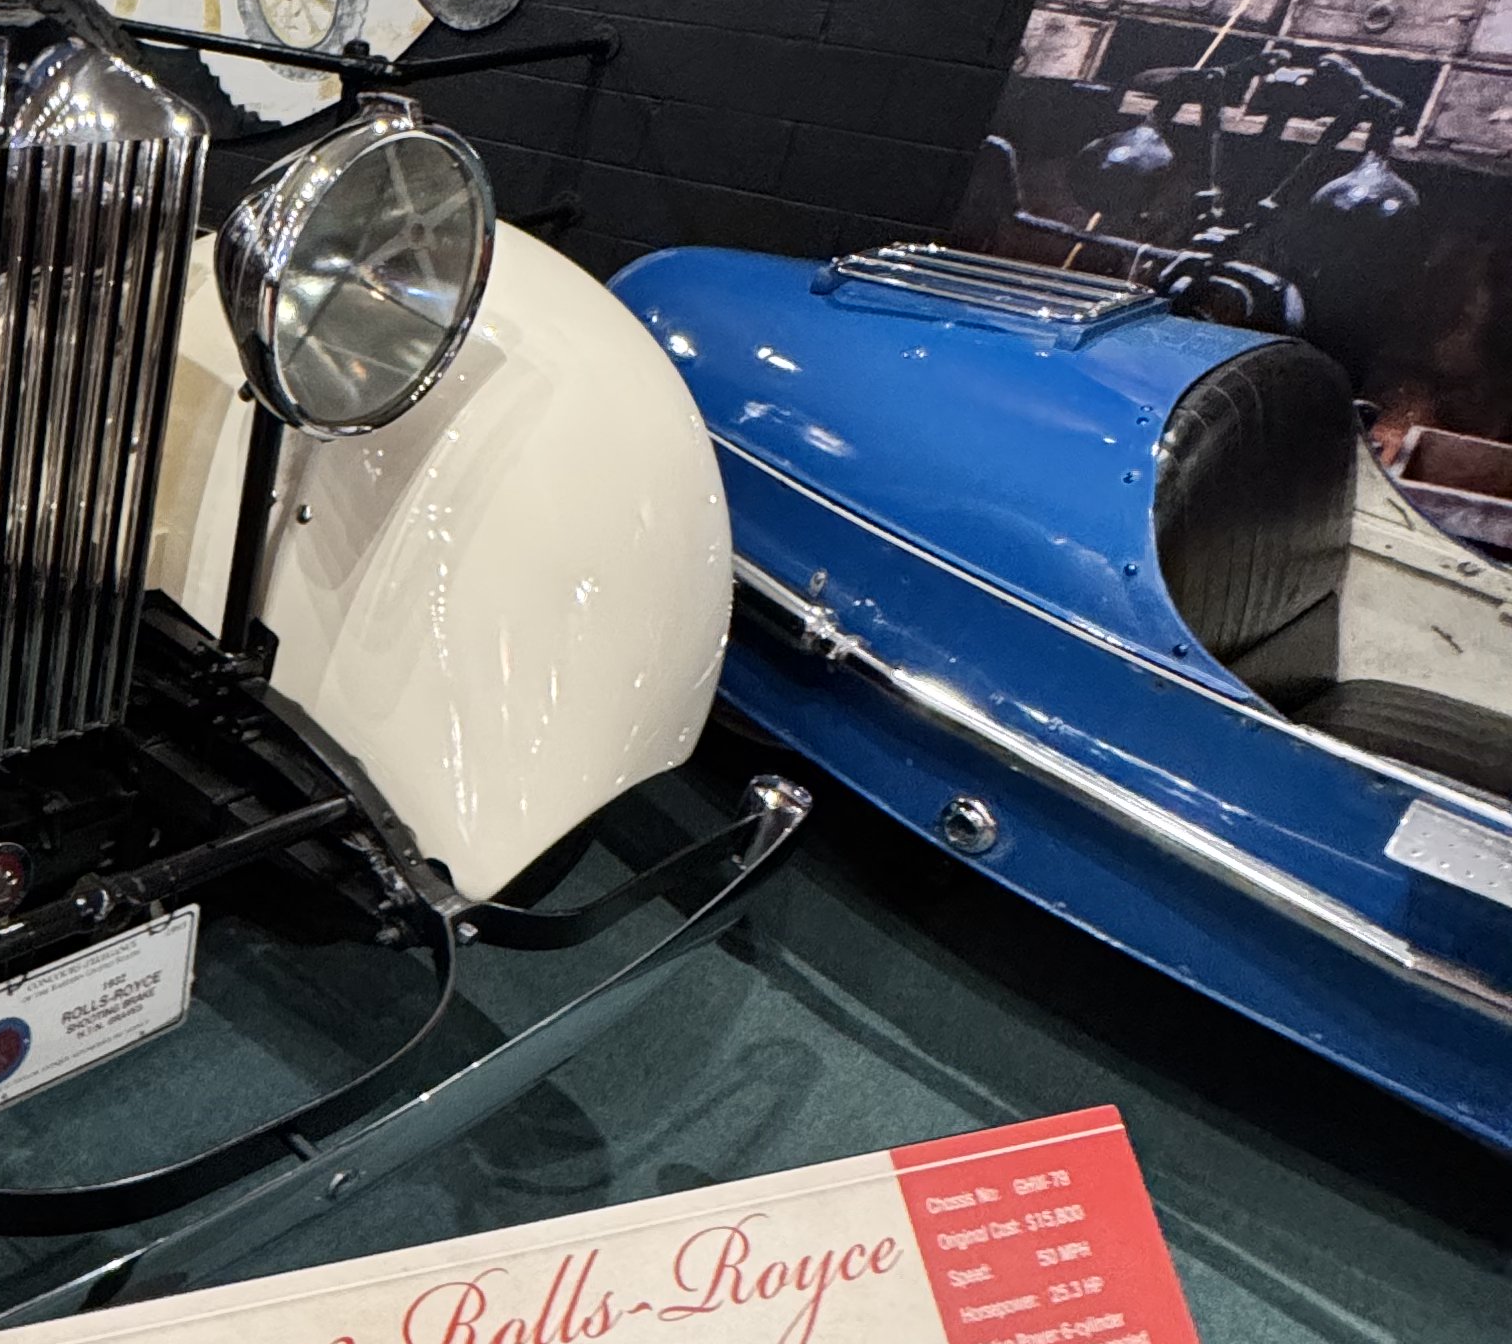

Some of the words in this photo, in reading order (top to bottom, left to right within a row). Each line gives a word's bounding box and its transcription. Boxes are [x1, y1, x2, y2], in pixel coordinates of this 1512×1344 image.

[61, 970, 162, 1026] ROLLS-ROYCE
[925, 1193, 976, 1214] Chassis
[937, 1226, 988, 1250] Original
[1025, 1204, 1084, 1231] $15,800
[947, 1265, 993, 1287] Speed:
[1036, 1247, 1058, 1266] 50
[1057, 1241, 1091, 1261] MPH
[960, 1295, 1038, 1322] Horsepower:
[1048, 1280, 1083, 1303] 25.3
[1082, 1275, 1103, 1294] HP
[1059, 1313, 1124, 1339] 6-cylinder
